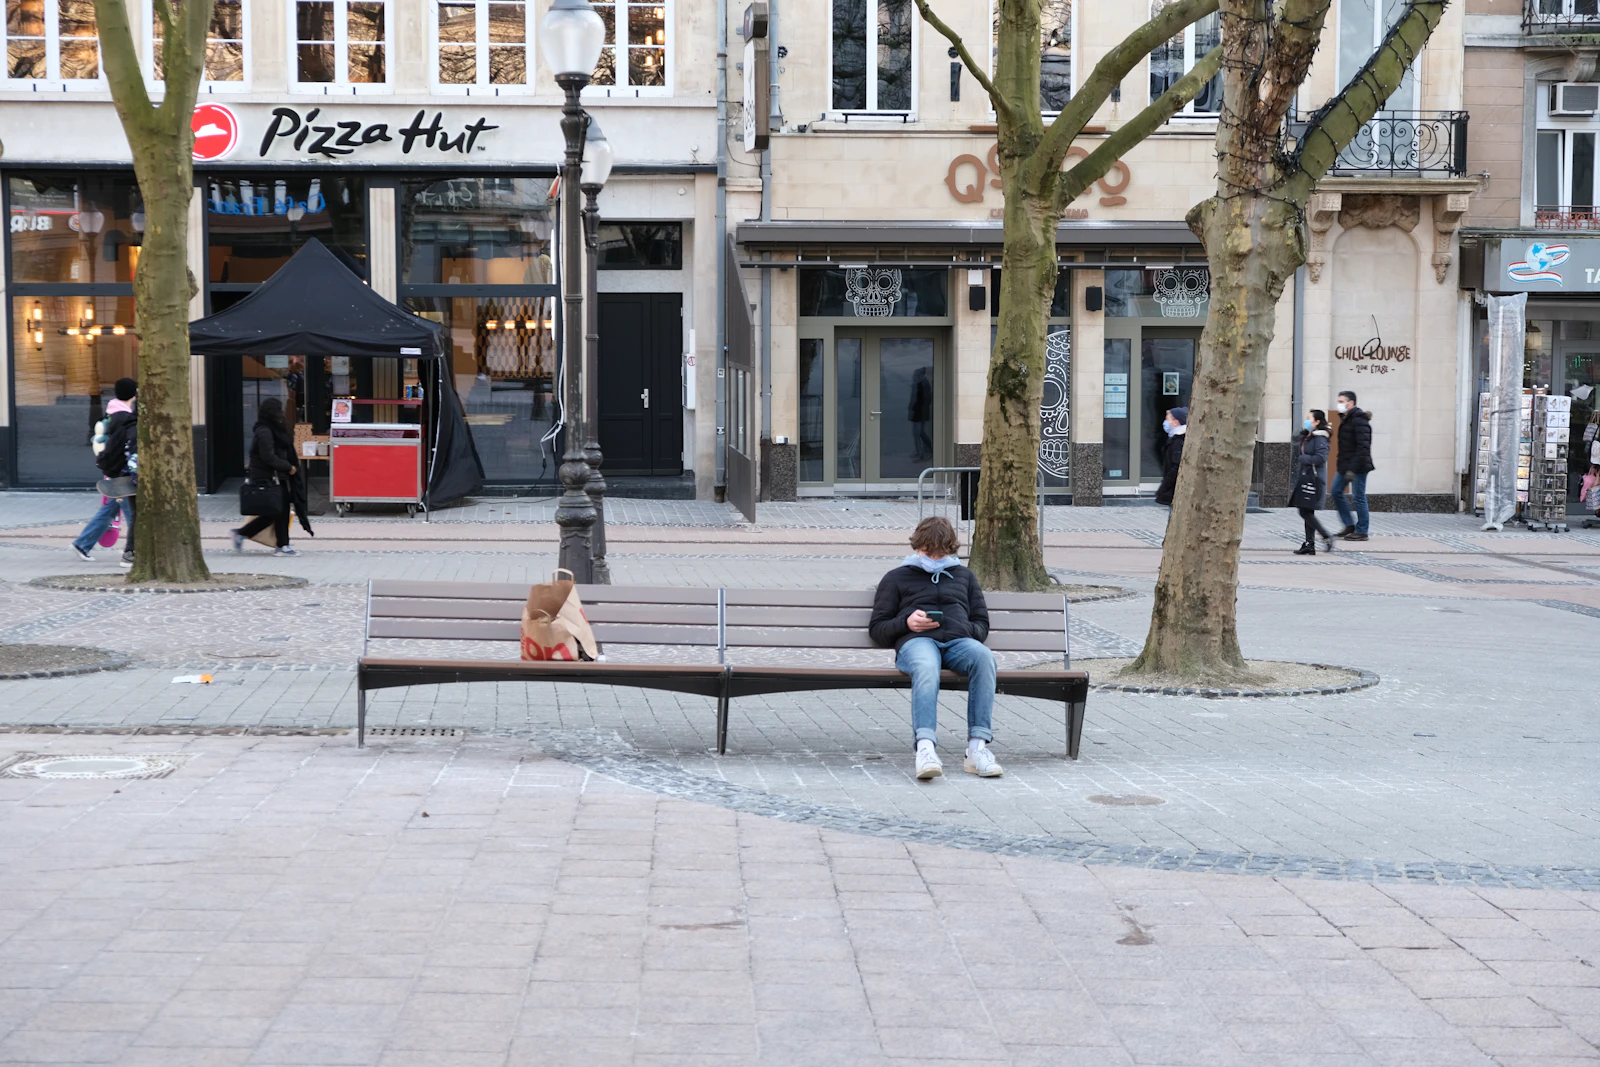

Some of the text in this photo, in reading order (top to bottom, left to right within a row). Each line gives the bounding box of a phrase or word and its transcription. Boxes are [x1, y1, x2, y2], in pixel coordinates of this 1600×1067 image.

[260, 107, 499, 158] Pizza Hut
[1335, 346, 1364, 361] CHILL
